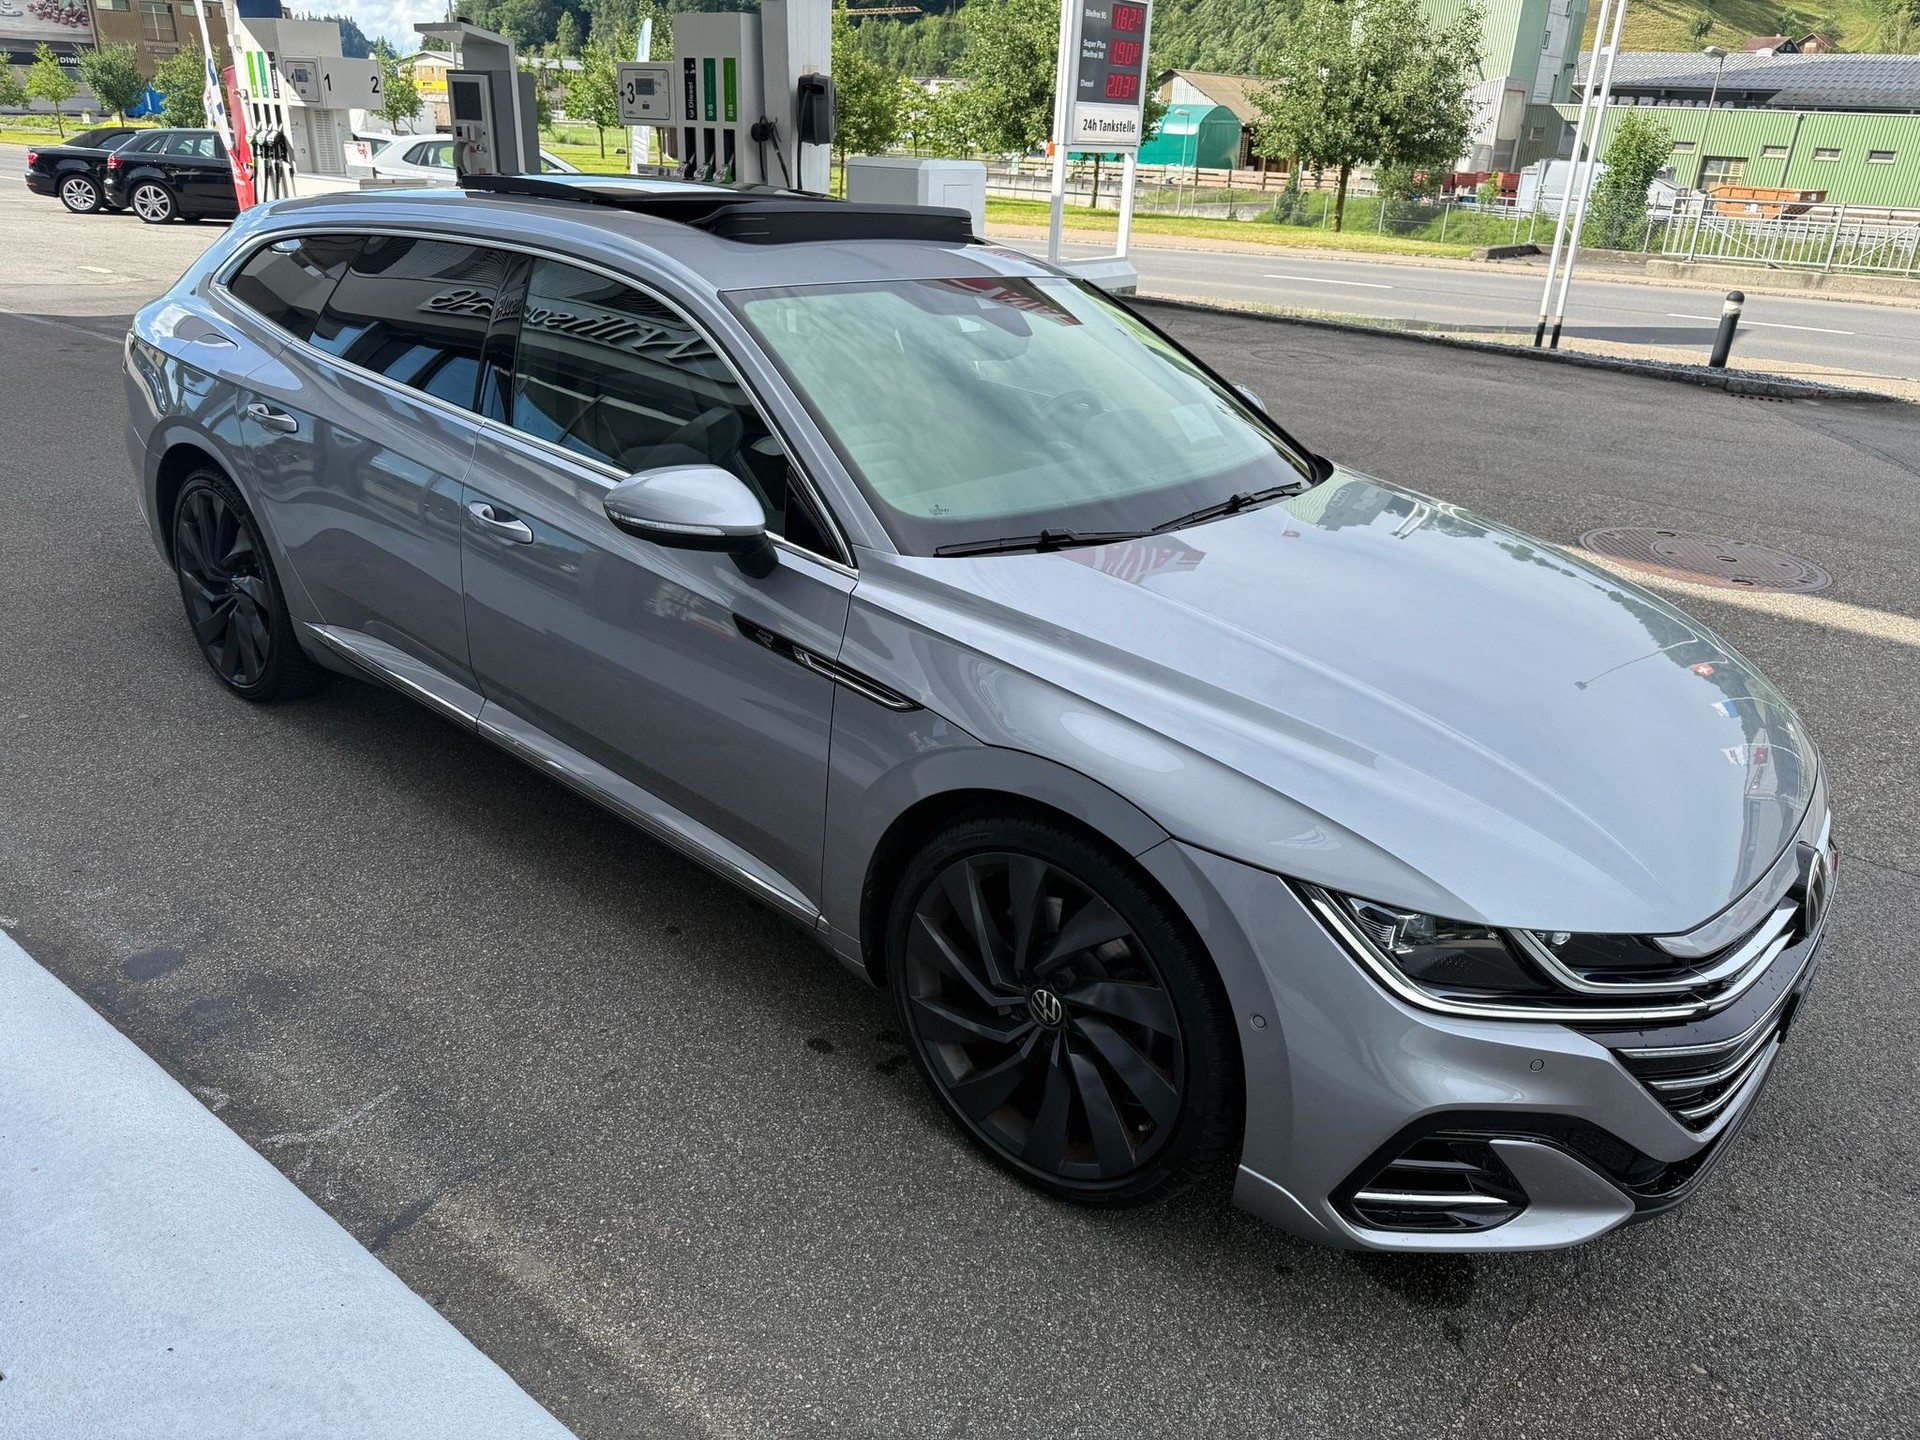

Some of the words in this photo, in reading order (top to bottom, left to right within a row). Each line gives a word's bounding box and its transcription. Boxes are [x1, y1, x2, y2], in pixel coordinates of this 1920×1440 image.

[324, 73, 332, 92] 1
[370, 76, 380, 93] 2
[1080, 79, 1095, 88] Diesel
[627, 82, 635, 104] 3
[1083, 118, 1098, 131] 24h
[1099, 119, 1136, 133] Tankstelle
